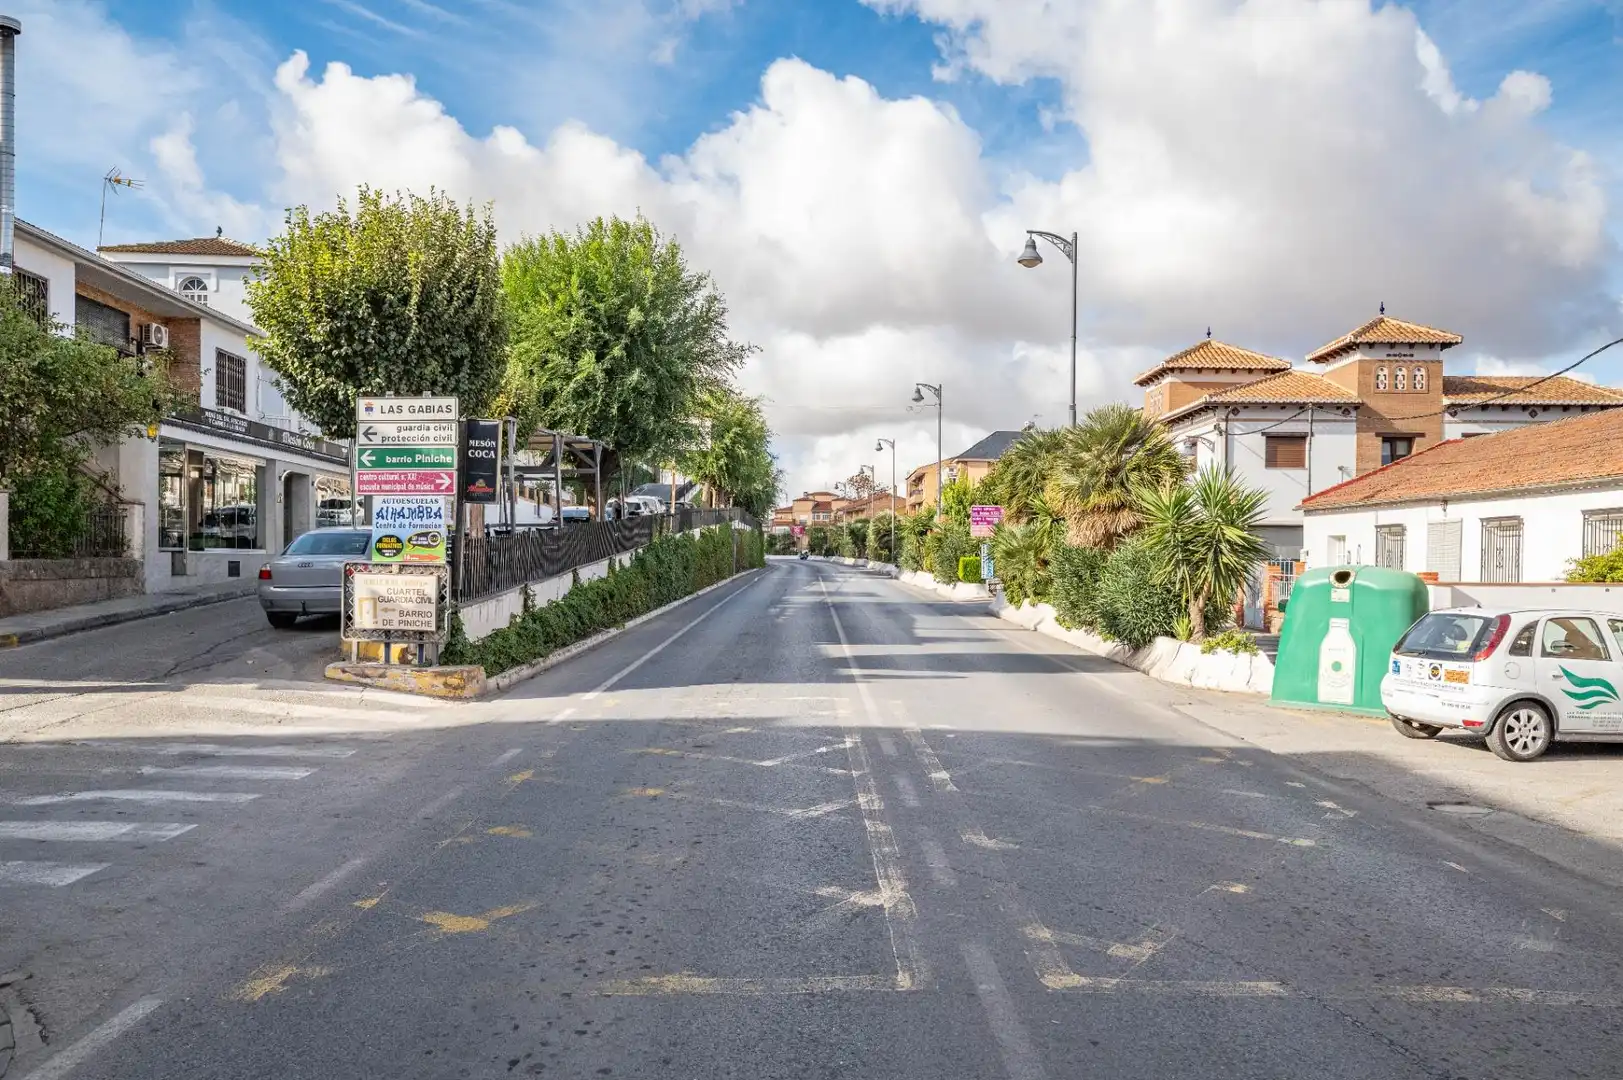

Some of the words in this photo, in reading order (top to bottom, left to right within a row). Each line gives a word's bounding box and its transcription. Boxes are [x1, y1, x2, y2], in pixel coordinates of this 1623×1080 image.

[380, 405, 403, 414] LAS
[408, 404, 452, 414] GABIAS
[396, 424, 430, 433] guardia
[381, 434, 430, 443] protección
[469, 439, 496, 447] MESÓN
[415, 454, 452, 462] Piniche
[468, 450, 495, 458] COCA
